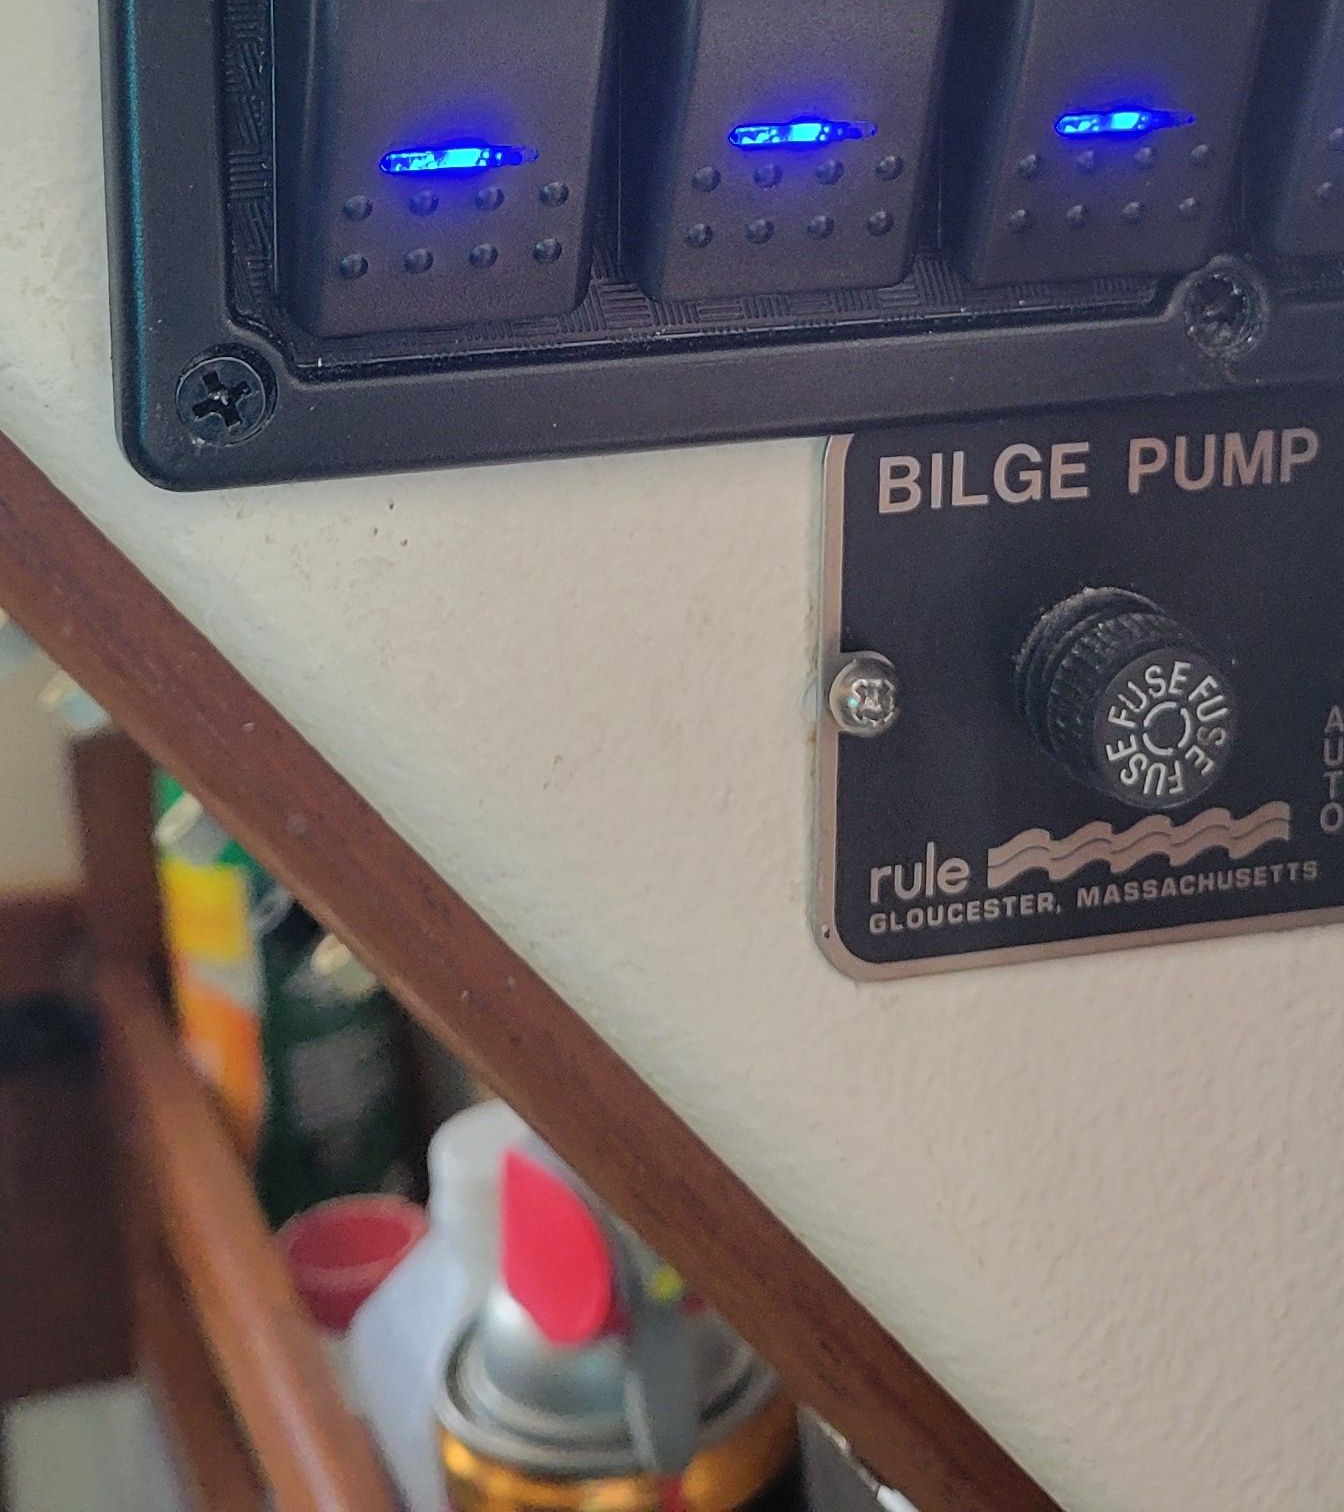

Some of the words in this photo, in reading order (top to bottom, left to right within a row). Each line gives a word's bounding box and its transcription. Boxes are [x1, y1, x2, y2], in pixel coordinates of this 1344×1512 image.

[878, 441, 1091, 515] BILGE
[1127, 426, 1319, 496] PUMP
[1107, 660, 1192, 730] FUSE
[1188, 674, 1229, 777] FUSE
[1105, 733, 1184, 796] FUSE
[868, 891, 1062, 935] GLOUCESTER,
[1076, 860, 1319, 909] MASSACHUSETTS
[869, 841, 971, 904] rule
